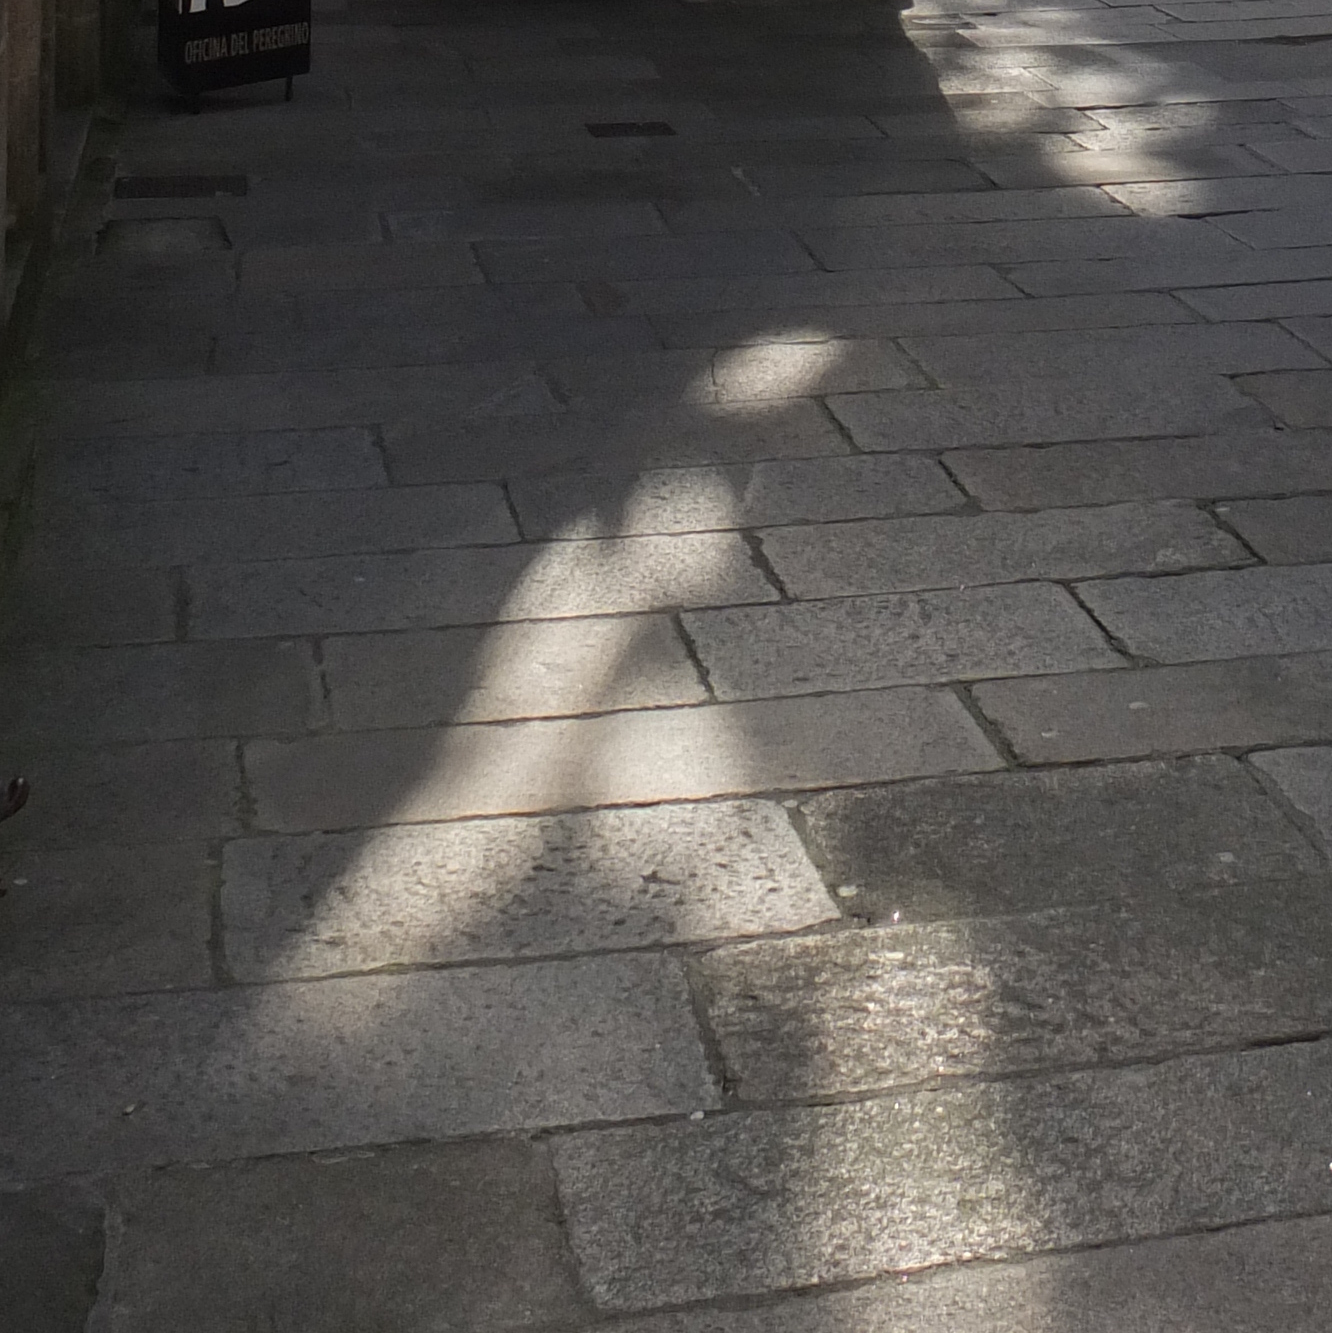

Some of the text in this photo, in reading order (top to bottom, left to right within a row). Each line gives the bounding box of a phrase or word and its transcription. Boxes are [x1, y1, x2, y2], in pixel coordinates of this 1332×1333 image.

[185, 22, 309, 64] OFICINA DEL PEREGRINO
